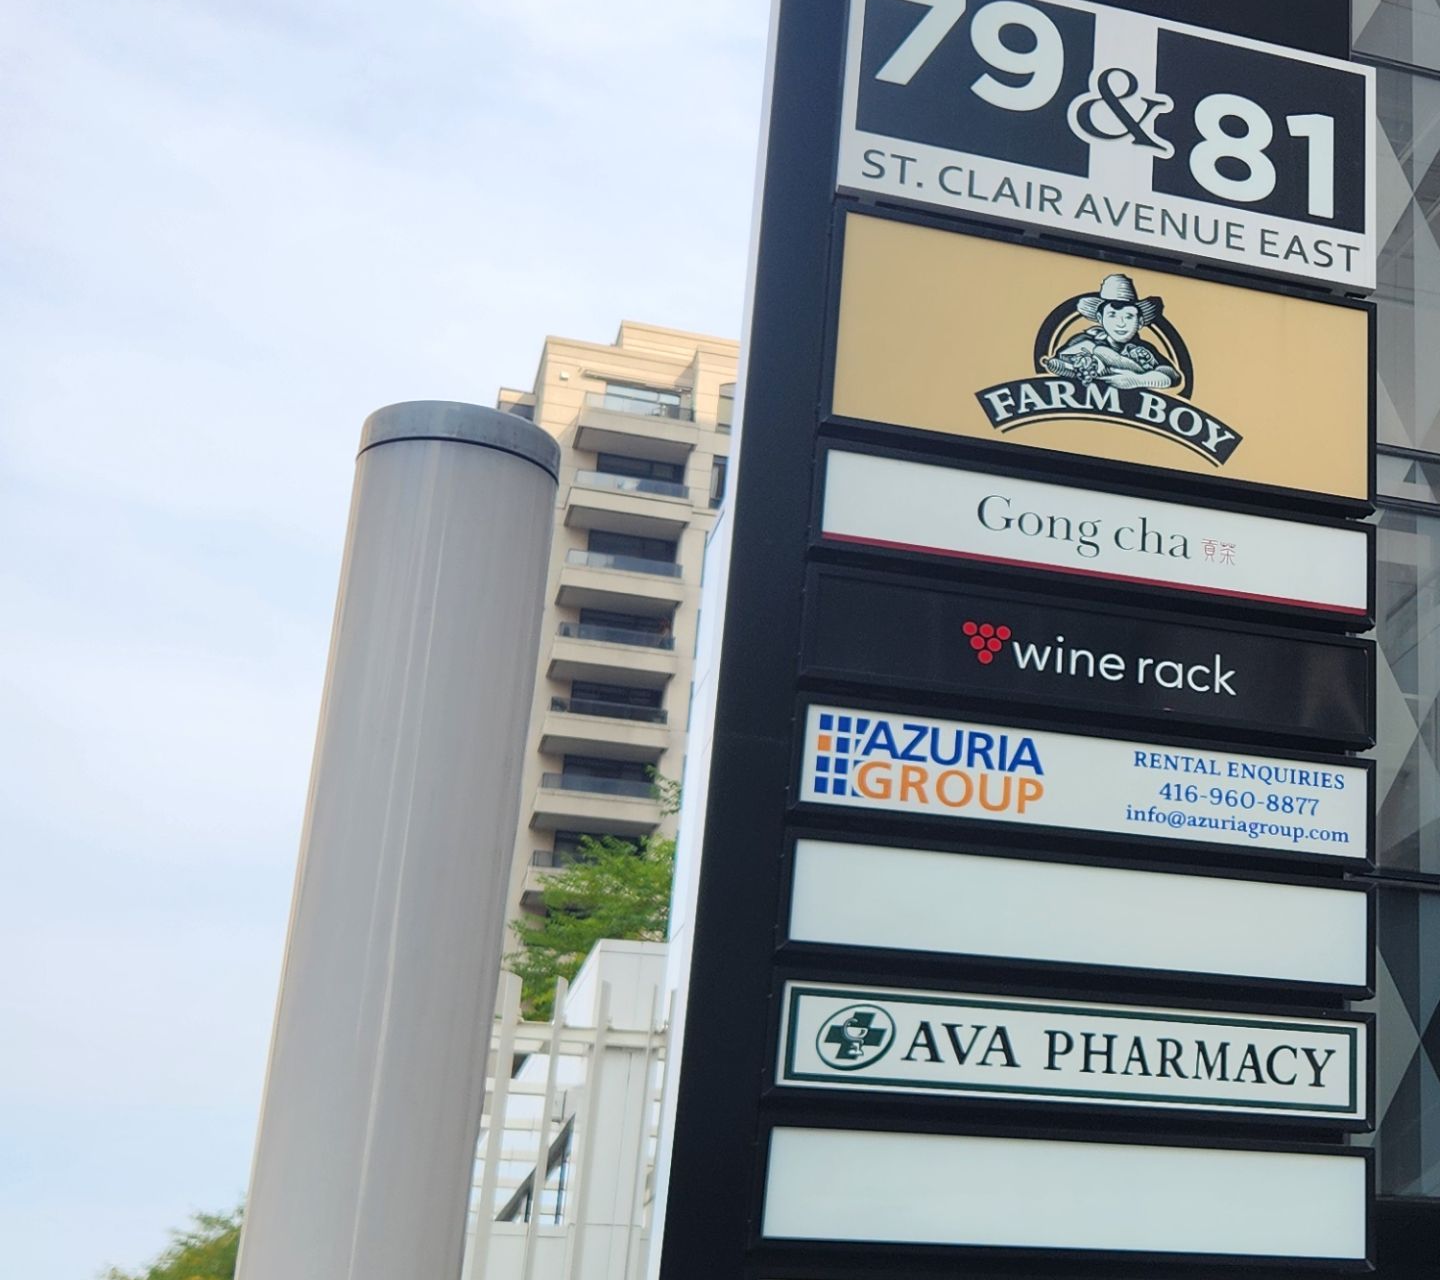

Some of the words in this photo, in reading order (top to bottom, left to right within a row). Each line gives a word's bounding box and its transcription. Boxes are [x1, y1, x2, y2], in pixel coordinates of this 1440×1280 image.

[1075, 67, 1170, 151] &
[1189, 92, 1335, 220] 81
[861, 148, 924, 189] ST.
[938, 165, 1063, 217] CLAIR
[1074, 193, 1246, 252] AVENUE
[1260, 230, 1359, 273] EAST
[985, 381, 1121, 423] FARM
[1134, 384, 1236, 454] BOY
[976, 494, 1101, 558] Gong
[1113, 516, 1191, 559] cha
[1012, 635, 1126, 681] wine
[1137, 653, 1238, 695] rack
[861, 720, 1045, 776] AZURIA
[1133, 750, 1222, 777] RENTAL
[1227, 761, 1346, 790] ENQUIRIES
[856, 764, 1045, 815] GROUP
[1158, 783, 1320, 817] 416-960-8877
[1125, 804, 1350, 844] info@azuriagroup.com
[901, 1020, 1021, 1069] AVA
[1043, 1029, 1336, 1088] PHARMACY
